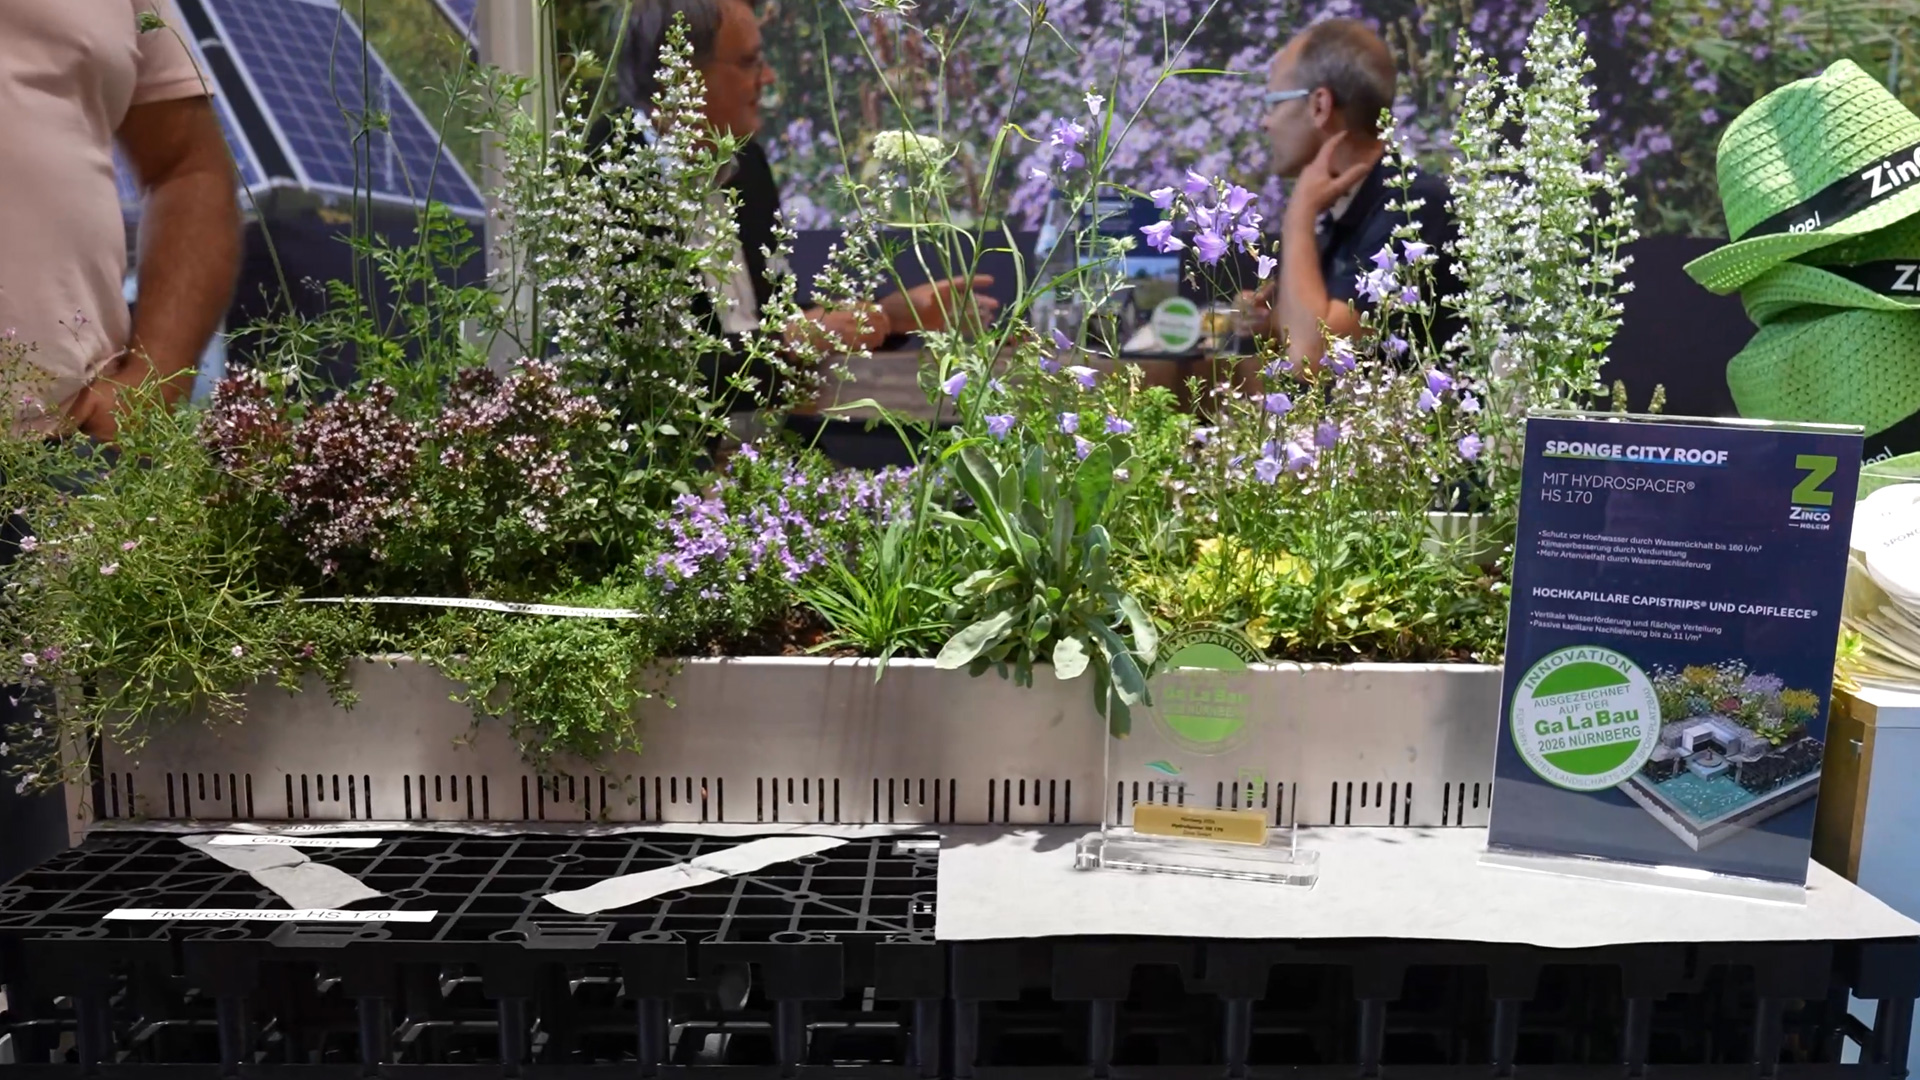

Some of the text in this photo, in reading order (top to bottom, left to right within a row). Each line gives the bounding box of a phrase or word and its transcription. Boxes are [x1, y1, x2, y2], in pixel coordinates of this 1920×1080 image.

[1545, 440, 1729, 465] SPONGE CITY ROOF
[1542, 472, 1696, 494] MIT HYDROSPACER®
[1791, 454, 1838, 506] Z
[1541, 489, 1593, 504] HS 170
[1800, 522, 1830, 530] HOLCIM
[1541, 530, 1568, 538] Schutz
[1582, 533, 1628, 543] Hochwasser
[1630, 537, 1653, 546] durch
[1655, 538, 1713, 550] Wasserrückhalt
[1715, 542, 1727, 550] bis
[1541, 540, 1687, 559] Klimaverbesserung durch Verdunstung
[1540, 549, 1711, 570] Mehr Artenvielfalt durch Wassernachlieferung
[1532, 586, 1818, 619] HOCHKAPILLARE CAPISTRIPS® UND CAPIFLEECE®
[1533, 619, 1560, 629] Passive
[1562, 622, 1593, 632] kapillare
[1595, 625, 1648, 638] Nachlieferung
[1649, 630, 1661, 638] bis
[1534, 610, 1566, 620] Vertikale
[1567, 613, 1631, 627] Wasserförderung
[1650, 620, 1681, 631] flächige
[1682, 623, 1722, 635] Verteilung
[1523, 650, 1632, 690] INNOVATION
[1534, 685, 1631, 708] AUSGEZEICHNET
[1559, 700, 1609, 715] AUF DER
[1538, 725, 1642, 752] 2026 NÜRNBERG
[150, 909, 392, 920] HydroSpacer HS 170
